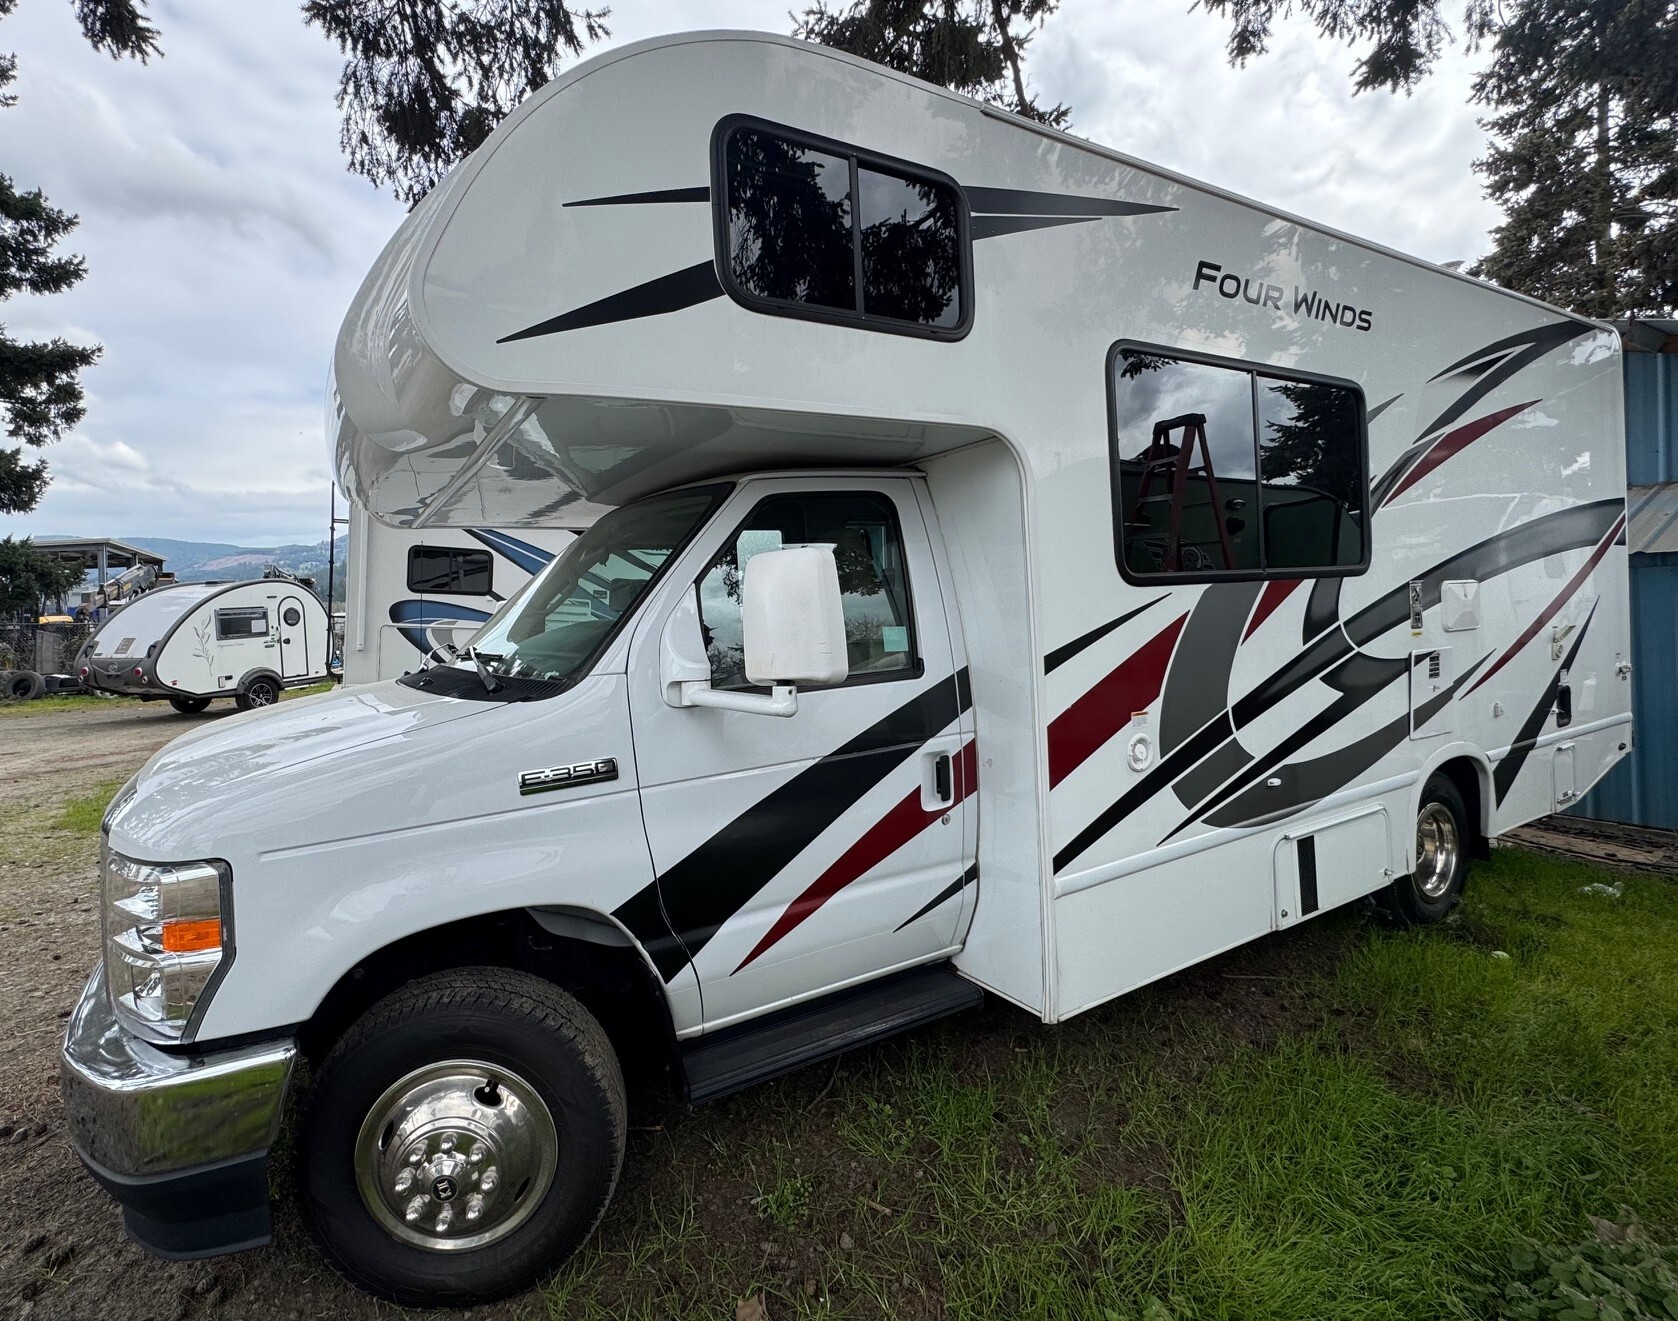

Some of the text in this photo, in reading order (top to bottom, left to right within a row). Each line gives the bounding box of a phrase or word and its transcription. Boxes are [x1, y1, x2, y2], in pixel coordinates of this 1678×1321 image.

[1192, 260, 1373, 332] FOUR WINDS
[520, 759, 617, 786] E-350
